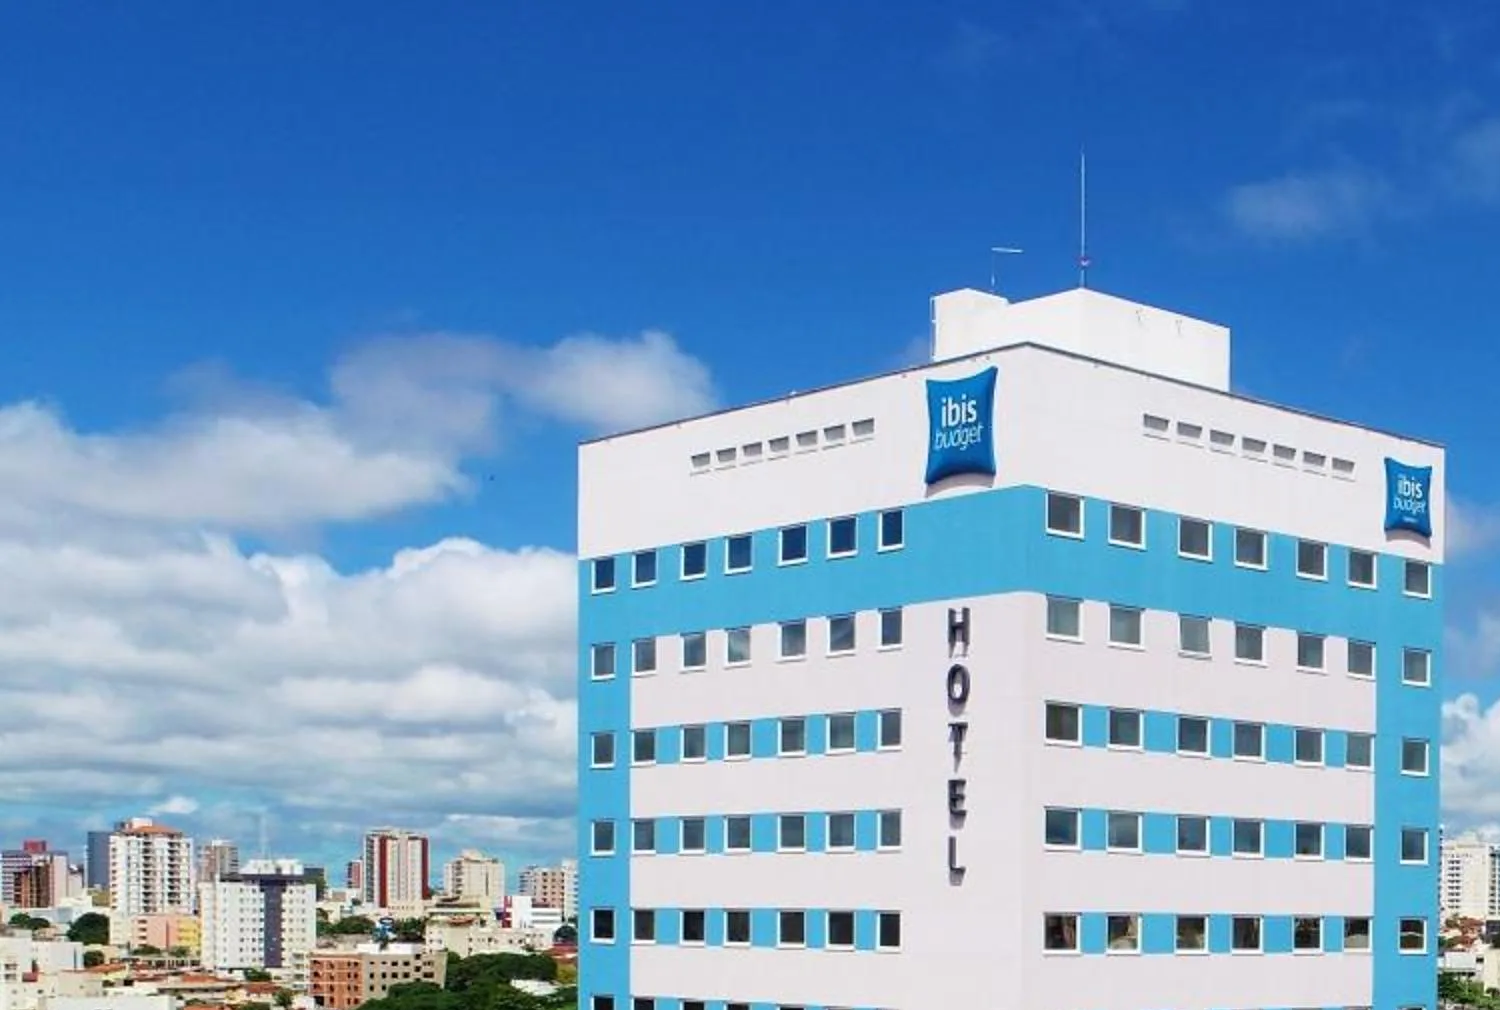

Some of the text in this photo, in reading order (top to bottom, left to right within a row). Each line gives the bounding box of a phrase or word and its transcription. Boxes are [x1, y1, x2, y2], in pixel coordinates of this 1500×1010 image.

[941, 393, 977, 428] ibis
[934, 422, 984, 451] budget
[1397, 474, 1423, 499] ibis
[947, 606, 971, 876] HOTEL
